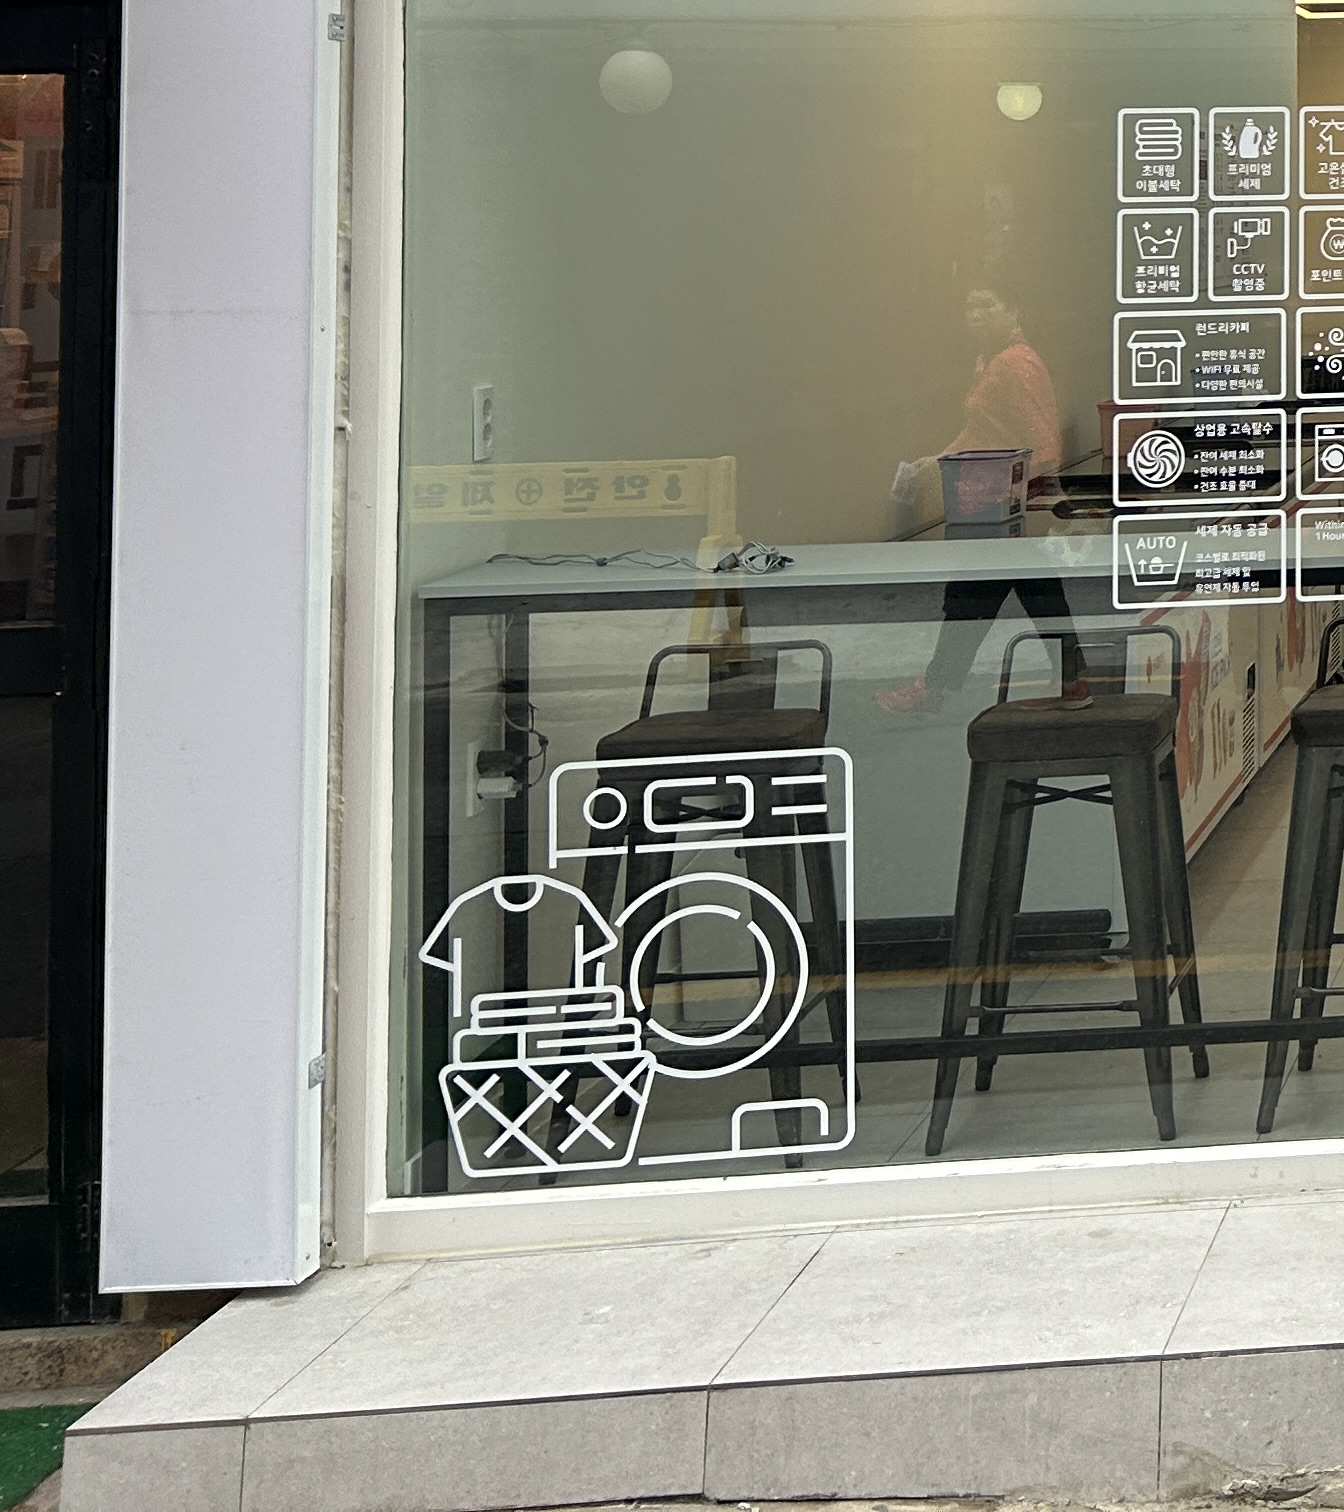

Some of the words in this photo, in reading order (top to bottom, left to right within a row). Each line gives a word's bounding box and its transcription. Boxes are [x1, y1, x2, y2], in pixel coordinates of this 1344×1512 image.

[1141, 164, 1176, 178] 초대형
[1227, 162, 1272, 177] 프리미엄
[1135, 179, 1182, 193] 이불세탁
[1237, 178, 1261, 191] 세제
[1134, 264, 1181, 278] 프리미엄
[1232, 262, 1267, 275] CCTV
[1310, 268, 1344, 283] 포인트
[1136, 535, 1177, 551] AUTO
